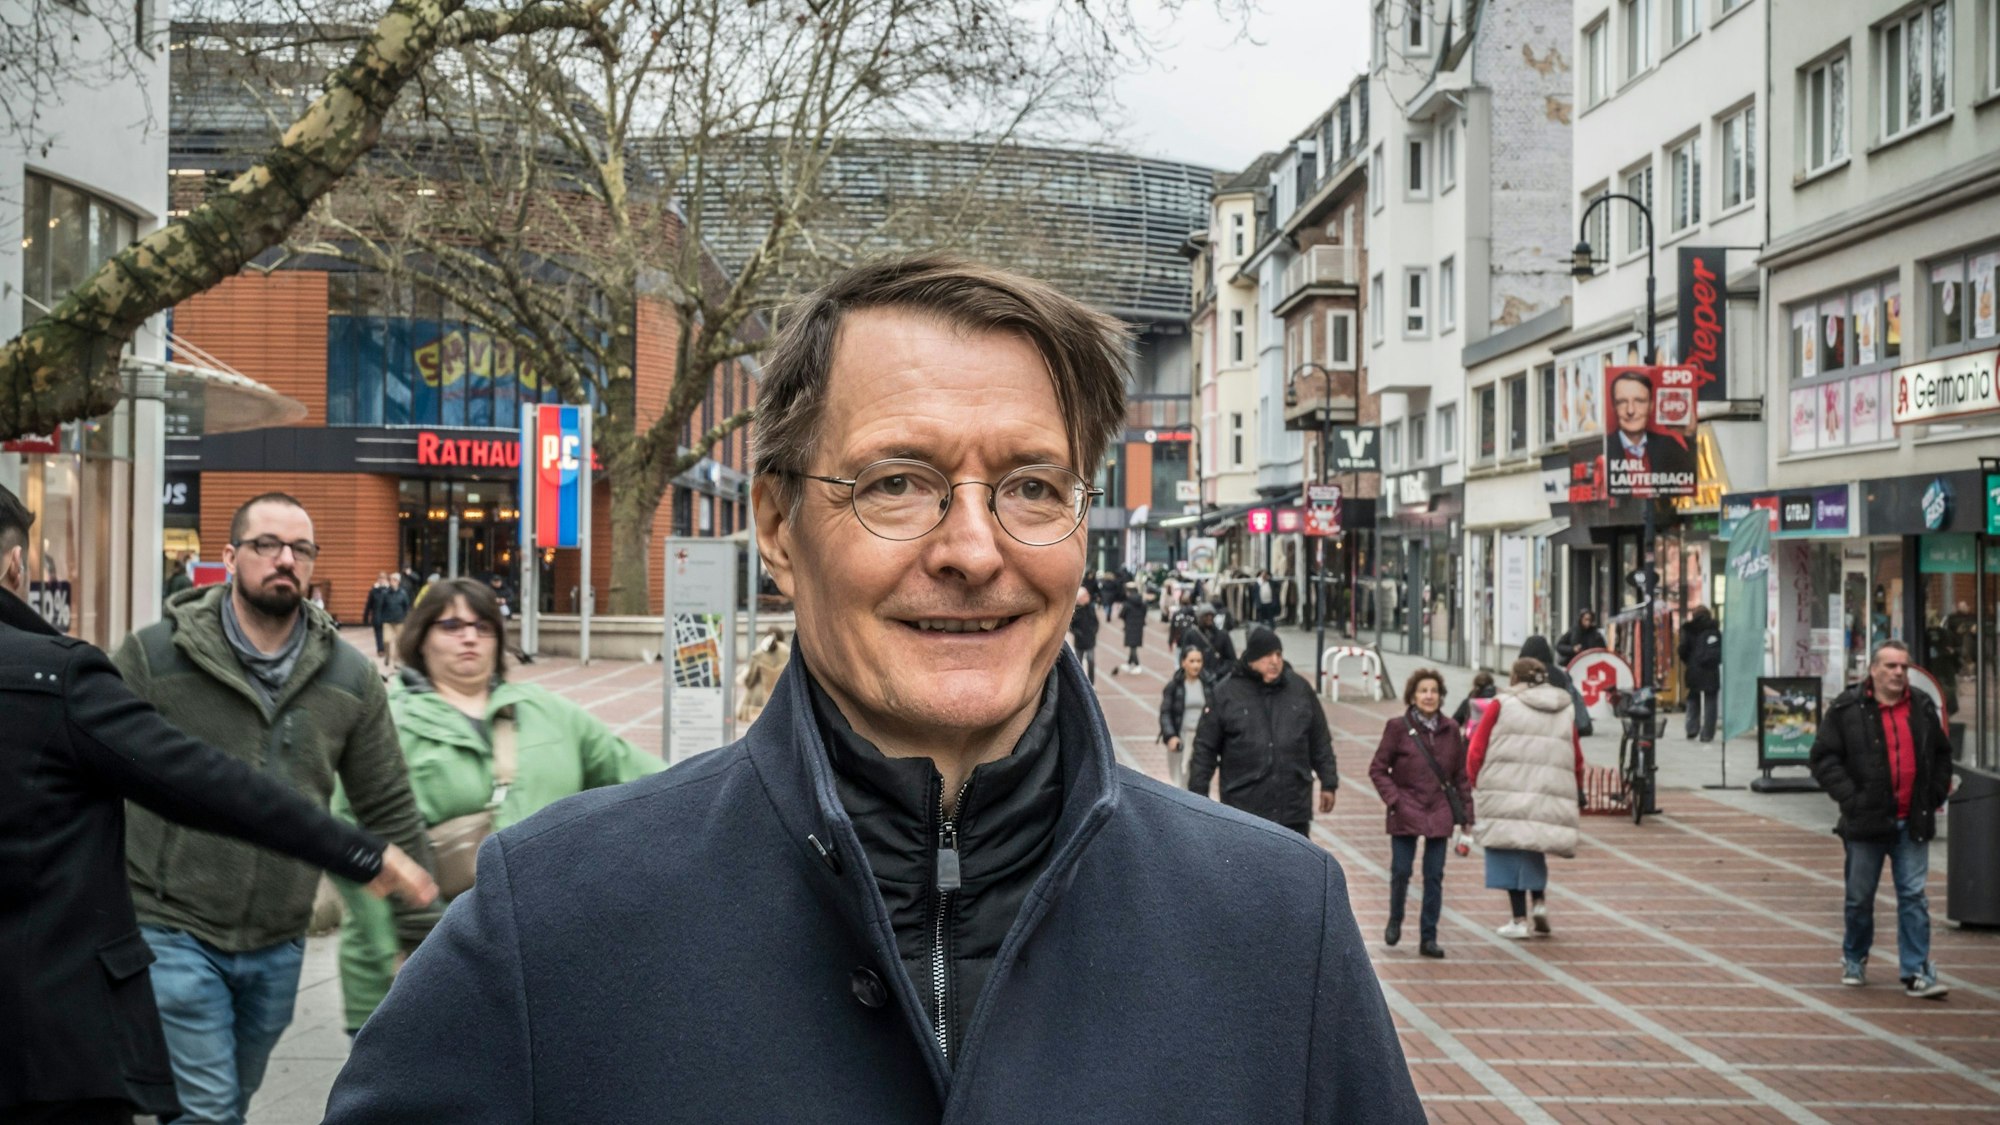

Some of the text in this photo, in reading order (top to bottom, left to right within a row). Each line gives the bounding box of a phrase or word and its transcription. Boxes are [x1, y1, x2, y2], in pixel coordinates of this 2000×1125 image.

[1685, 258, 1722, 387] Pieper
[1662, 370, 1693, 384] SPD
[1914, 361, 1989, 409] Germania
[1663, 401, 1685, 412] SPD
[418, 432, 522, 467] RATHAU
[1610, 459, 1645, 472] KARL
[1610, 473, 1694, 486] LAUTERBACH
